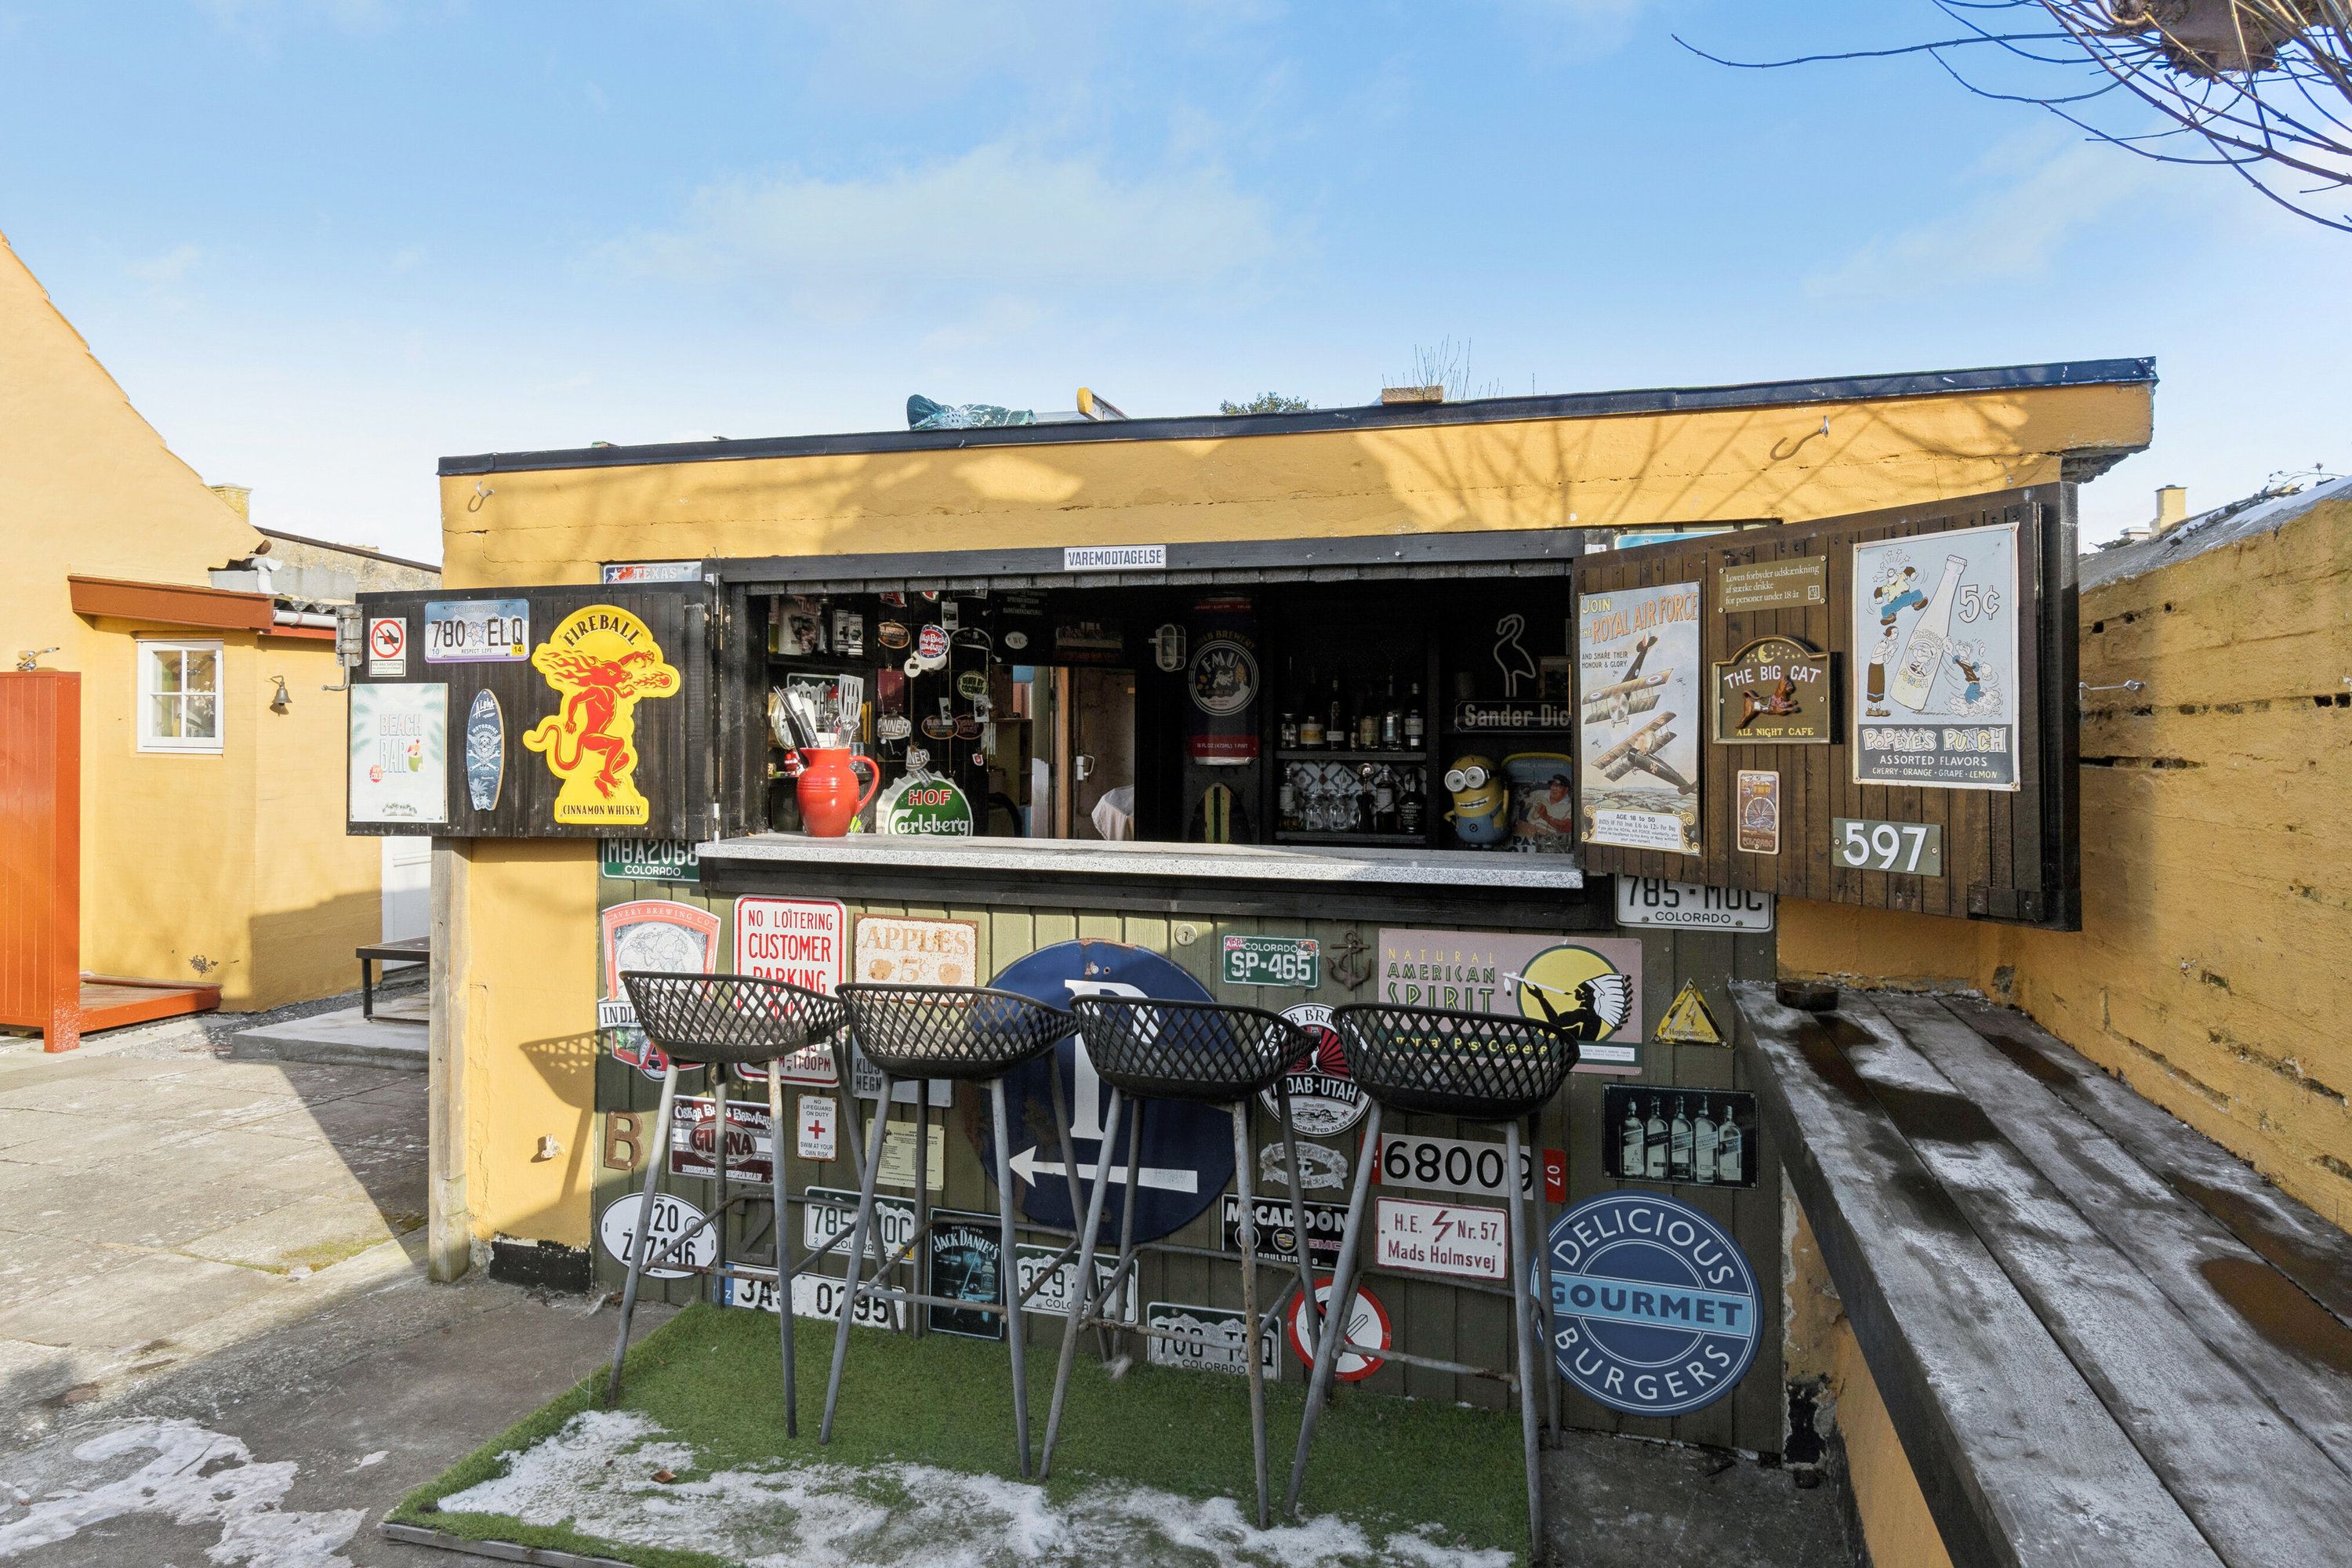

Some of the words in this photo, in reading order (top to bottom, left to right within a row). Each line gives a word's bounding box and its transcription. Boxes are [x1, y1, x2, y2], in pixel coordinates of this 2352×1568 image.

[1069, 549, 1162, 566] VAREMODTAGELSE
[633, 568, 677, 579] TEXAS
[1726, 574, 1744, 583] Loven
[1747, 570, 1773, 581] forbyder
[1774, 564, 1819, 577] udskænkning
[1725, 585, 1733, 593] af
[1733, 583, 1752, 593] stærke
[1754, 581, 1774, 590] drikke
[1726, 596, 1734, 604] for
[1736, 594, 1762, 606] personer
[1764, 592, 1783, 601] under
[1792, 590, 1799, 598] år
[453, 604, 499, 613] COLORADO
[1582, 597, 1611, 614] JOIN
[1958, 584, 2000, 623] 5¢
[1581, 628, 1592, 639] THE
[1592, 609, 1631, 644] ROYAL
[1633, 601, 1657, 633] AIR
[1659, 593, 1698, 624] FORCE
[431, 620, 466, 648] 780
[488, 618, 523, 646] ELQ
[563, 615, 640, 647] FIREBALL
[1594, 651, 1611, 660] SHARE
[1724, 668, 1755, 689] THE
[1760, 665, 1781, 681] BIG
[1790, 665, 1822, 683] CAT
[1900, 668, 1928, 688] PUNCH
[380, 714, 423, 736] BEACH
[1465, 703, 1534, 728] Sander
[472, 724, 498, 735] MOTORBIKE
[1756, 728, 1783, 737] NIGHT
[1788, 728, 1814, 736] CAFE
[1862, 728, 1936, 752] POPEYE'S
[1943, 727, 2007, 753] PUNCH
[379, 739, 407, 773] BAR
[1880, 755, 1934, 765] ASSORTED
[1940, 756, 1987, 767] FLAVORS
[1904, 768, 1932, 777] ORANGE
[1969, 770, 1997, 779] LEMON
[909, 789, 952, 806] HOF
[563, 804, 604, 815] CINNAMON
[608, 804, 641, 815] WHISKY
[890, 809, 970, 837] Carlsberg
[1842, 822, 1928, 872] 597
[625, 866, 681, 877] COLORADO
[613, 908, 641, 919] AVERY
[647, 908, 692, 920] BREWING
[748, 909, 764, 927] NO
[775, 911, 833, 931] LOITERING
[1656, 911, 1731, 924] COLORADO
[748, 932, 831, 963] CUSTOMER
[863, 925, 969, 955] APPLES
[1244, 943, 1298, 953] COLORADO
[1232, 951, 1311, 981] SP-465
[1388, 948, 1494, 964] NATURAL
[1388, 961, 1495, 984] AMERICAN
[1388, 981, 1495, 1014] SPIRIT
[1273, 1077, 1313, 1094] OAB
[1320, 1081, 1357, 1103] UTAH
[674, 1105, 703, 1122] OSKAR
[703, 1104, 731, 1118] BLS
[733, 1108, 771, 1130] BREWERY
[1330, 1122, 1347, 1132] ALES
[604, 1109, 644, 1170] B
[691, 1129, 753, 1156] GUNA
[1547, 1165, 1561, 1186] 07
[1225, 1202, 1348, 1232] MCADDON
[1395, 1214, 1421, 1233] H.E.
[1457, 1220, 1476, 1240] Nr.
[1481, 1221, 1497, 1241] 57
[934, 1232, 959, 1253] JACK
[960, 1229, 1000, 1260] DANIEL'S
[1553, 1208, 1733, 1284] DELICIOUS
[1388, 1240, 1425, 1262] Mads
[1431, 1246, 1495, 1273] Holmsvej
[1551, 1281, 1743, 1327] GOURMET
[1182, 1359, 1246, 1374] COLORADO
[1555, 1327, 1730, 1400] BURGERS
